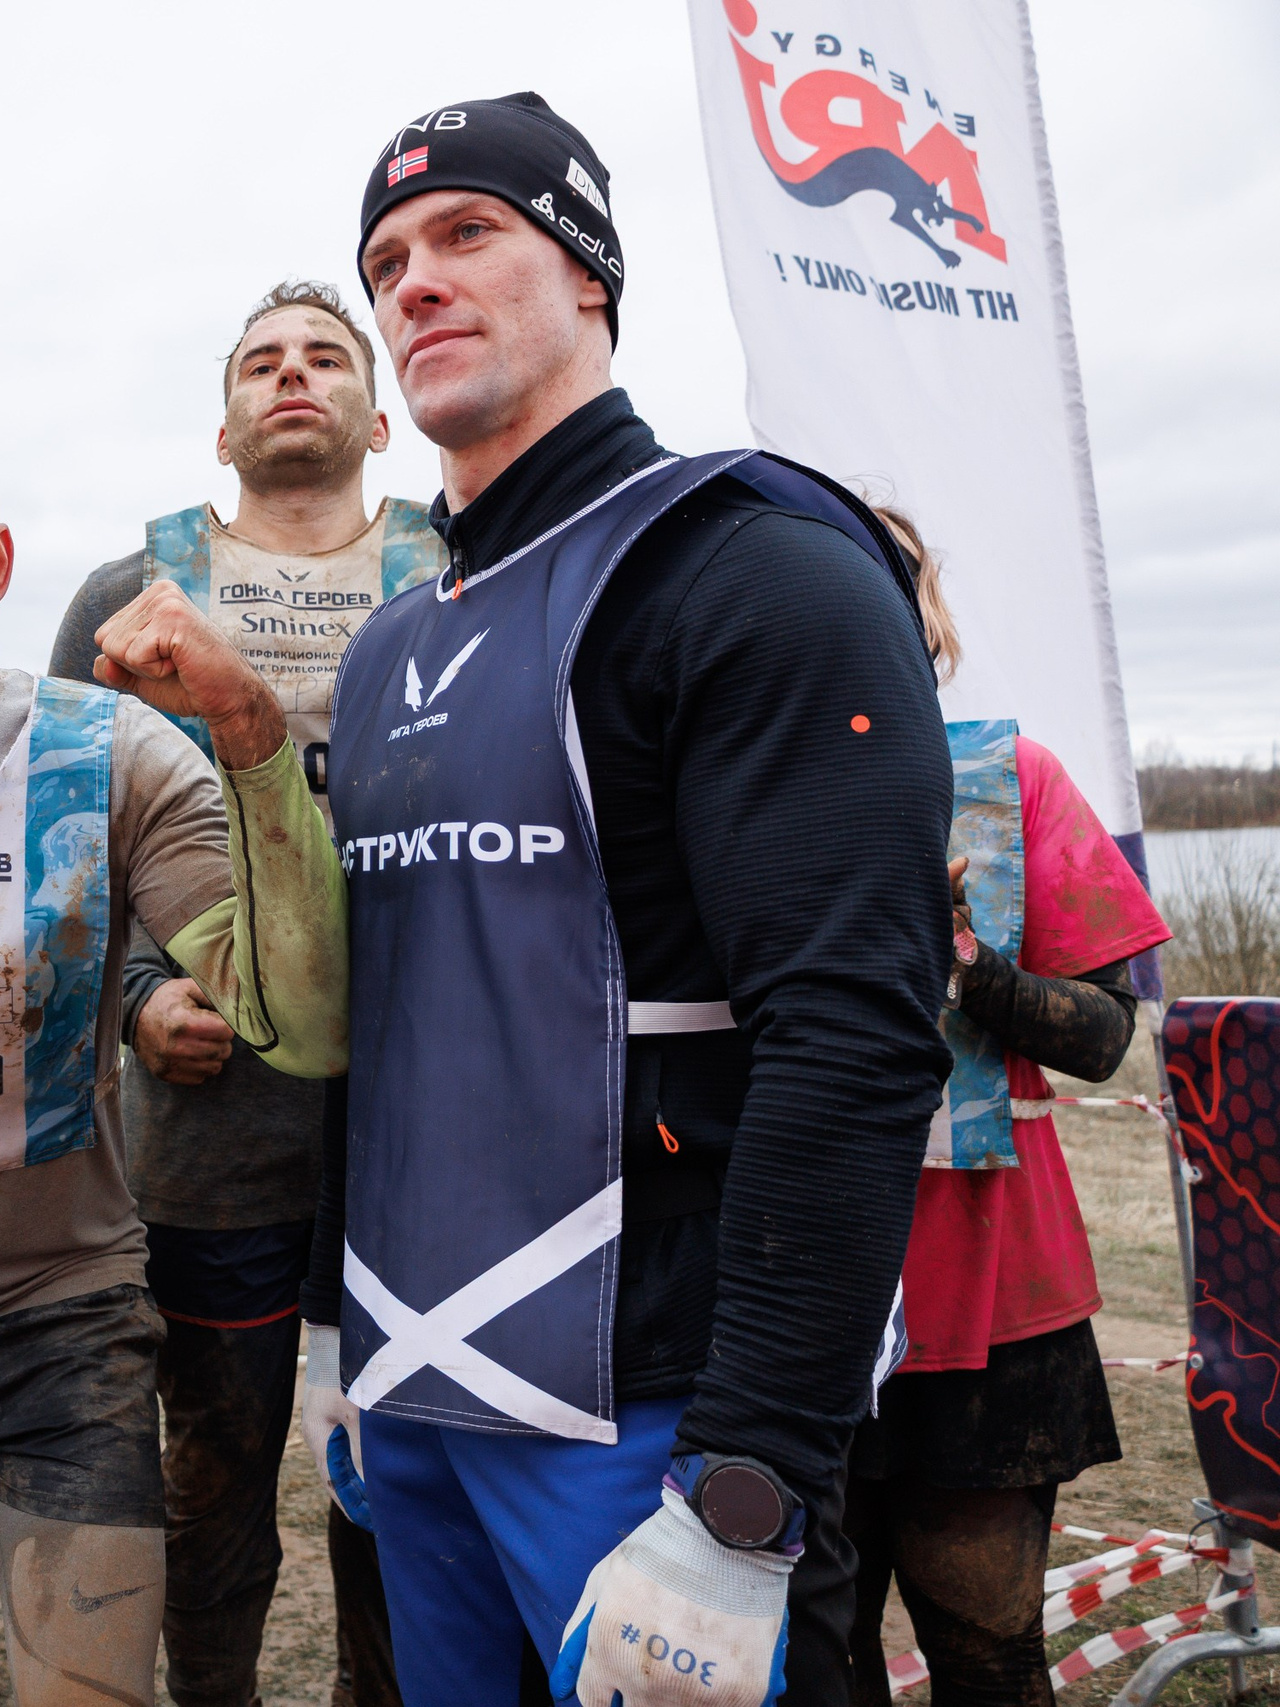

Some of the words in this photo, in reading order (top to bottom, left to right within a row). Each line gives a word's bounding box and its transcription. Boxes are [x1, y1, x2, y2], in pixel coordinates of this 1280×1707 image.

[373, 110, 468, 170] NB
[219, 583, 285, 602] ГОНКА
[292, 590, 373, 606] ГЕРОЕВ
[240, 611, 352, 638] Sminex
[240, 648, 344, 661] ПЕРФЕКЦИОНИСТ
[387, 725, 410, 742] ЛИГА
[411, 712, 449, 734] ГЕРОЕВ
[342, 822, 565, 878] СТРУКТОР
